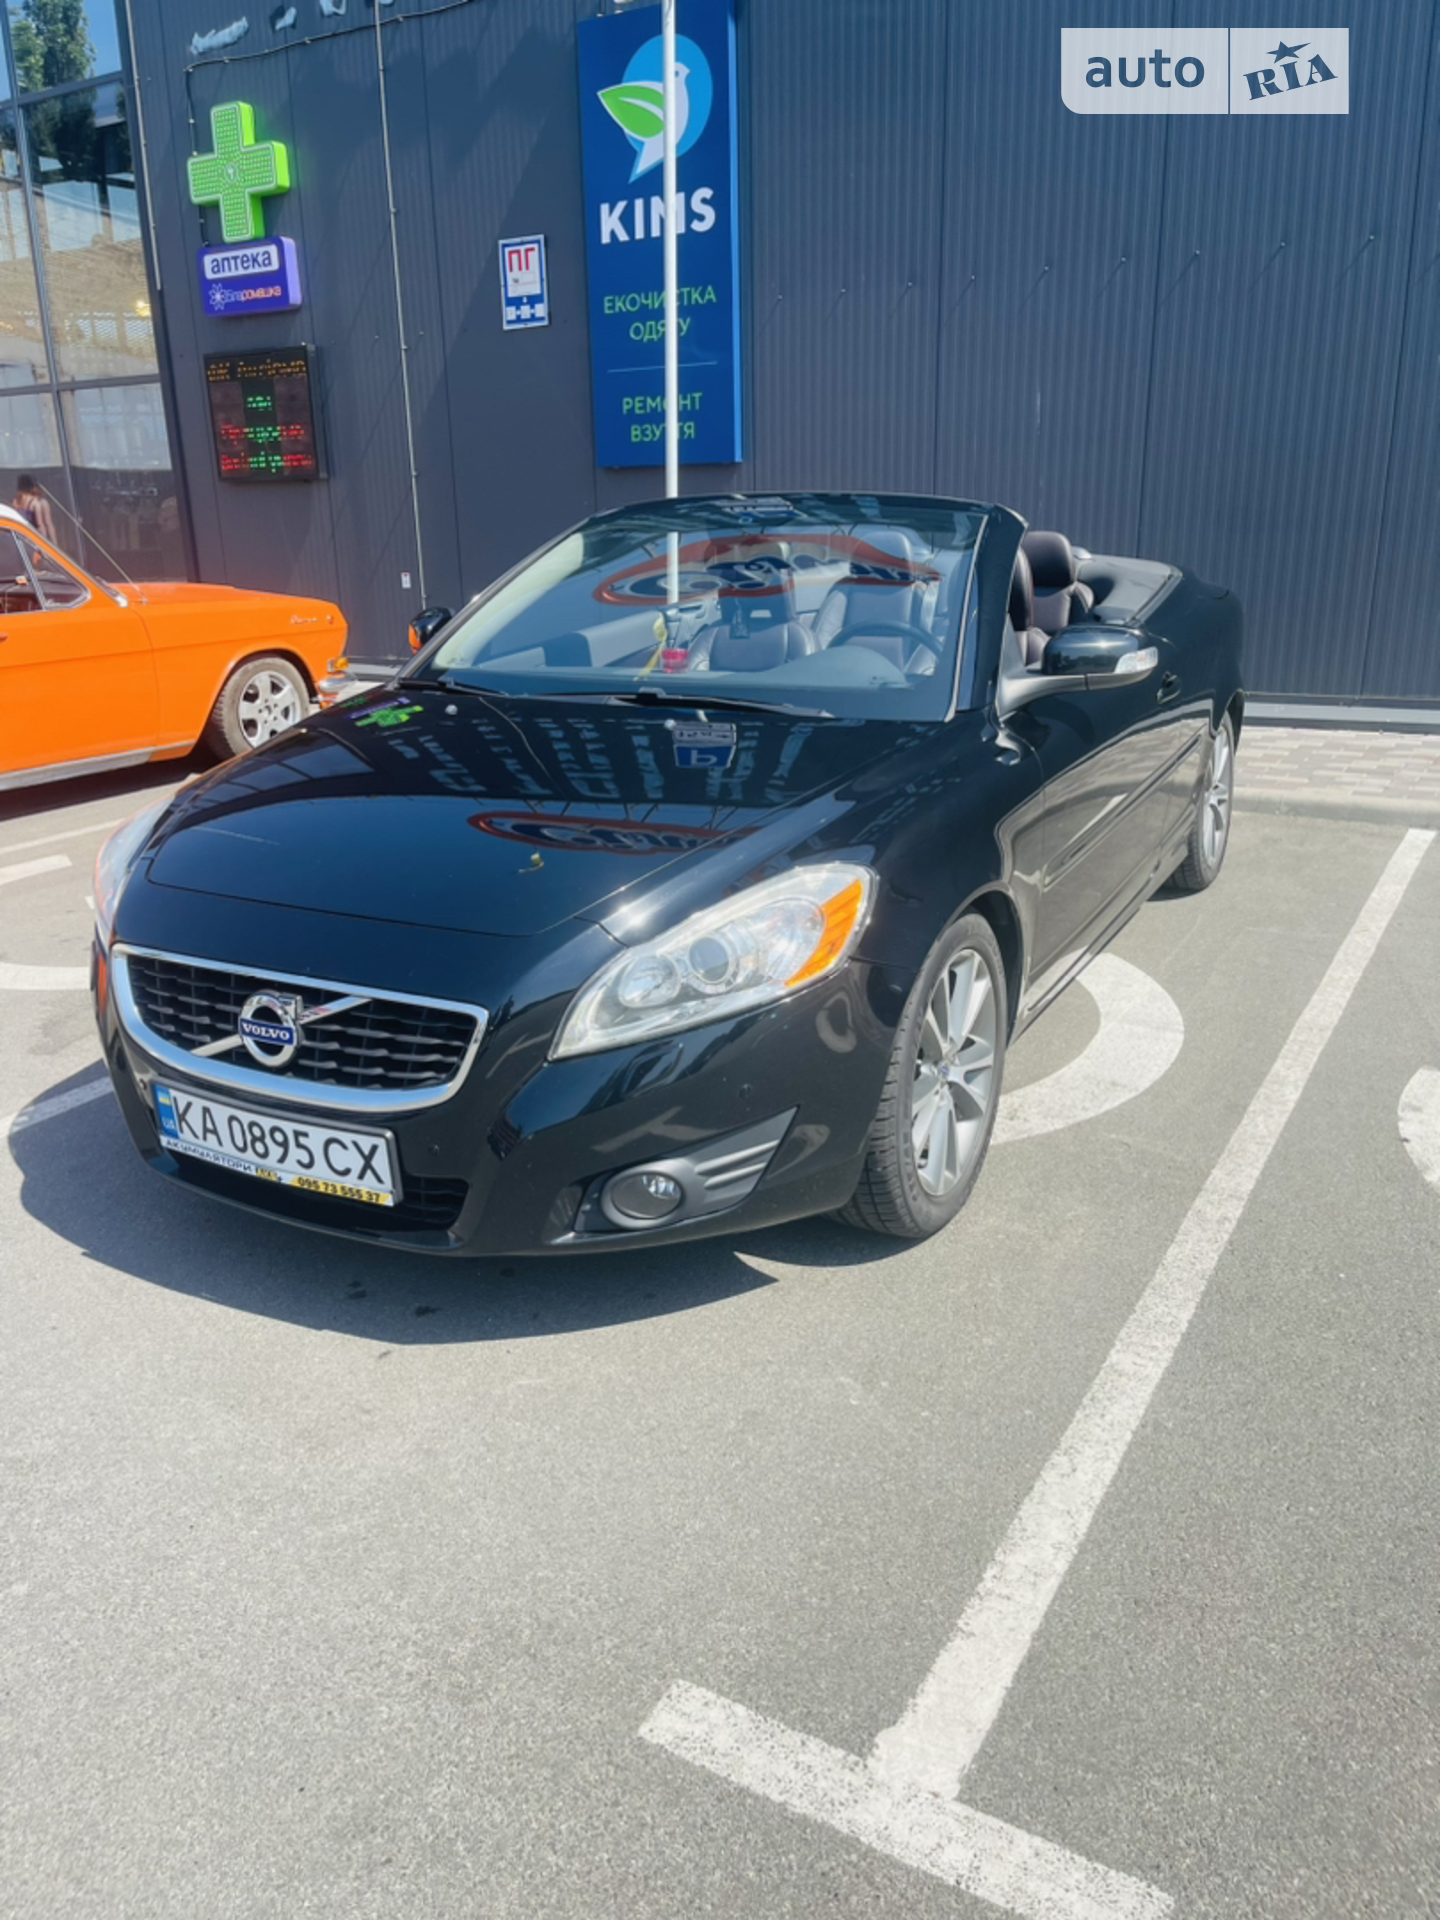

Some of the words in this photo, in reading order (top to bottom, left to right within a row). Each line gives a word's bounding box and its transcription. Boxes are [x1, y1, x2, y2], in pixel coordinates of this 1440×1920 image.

[600, 186, 716, 245] KIMS
[211, 250, 272, 275] аптека
[508, 247, 536, 273] ПГ
[604, 285, 717, 315] ЕКОЧИТКА
[629, 317, 691, 343] ОДЯУ
[622, 392, 703, 415] РЕМНТ
[630, 421, 696, 443] ВЗУТЯ
[242, 1021, 291, 1041] VOLVO
